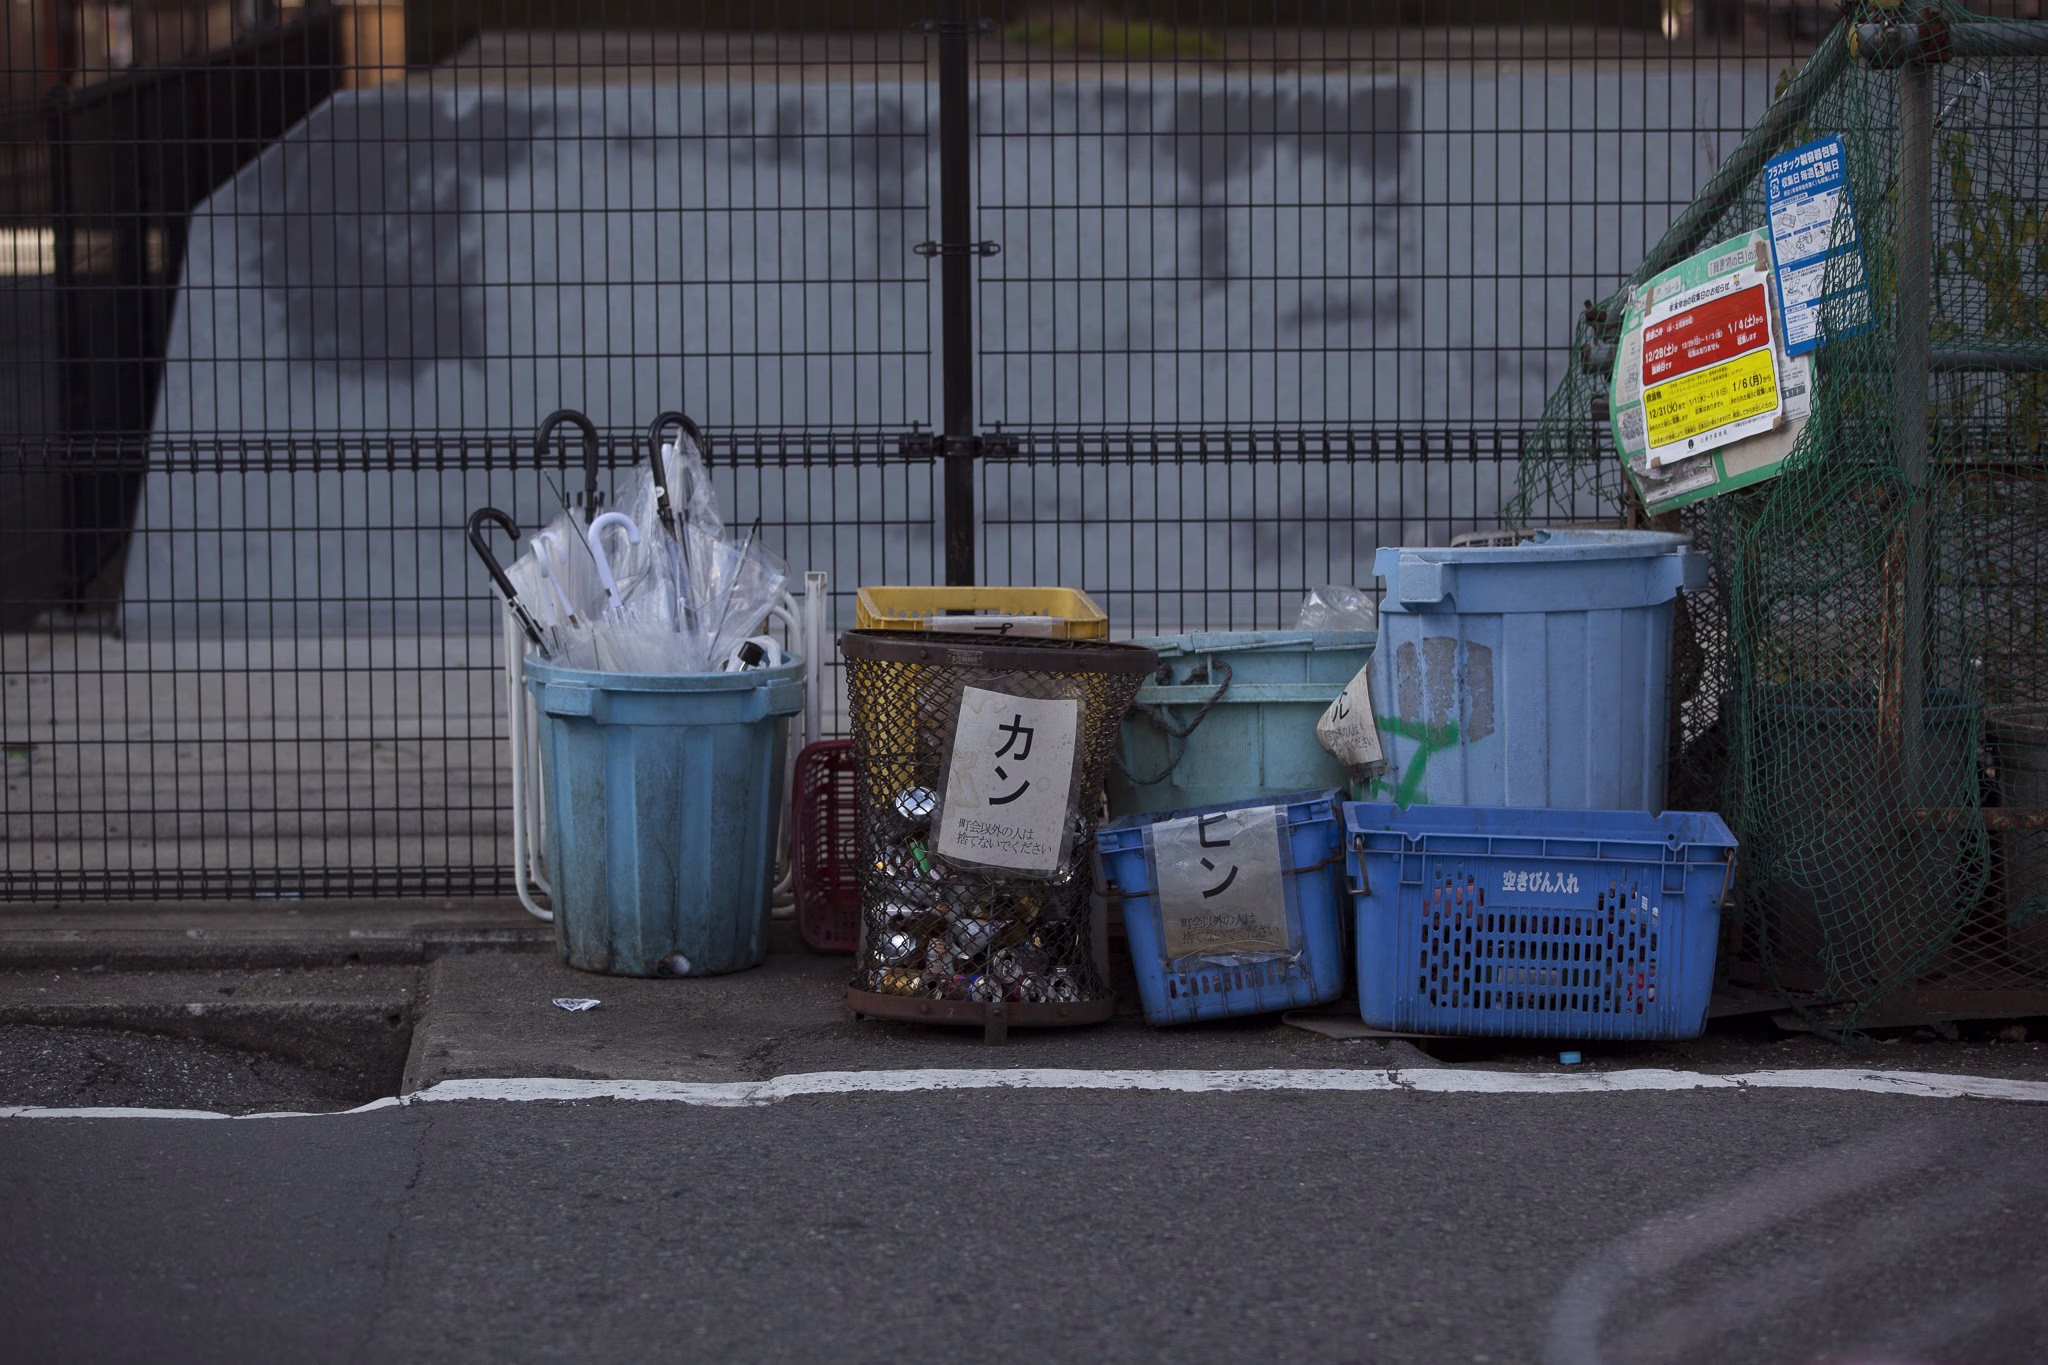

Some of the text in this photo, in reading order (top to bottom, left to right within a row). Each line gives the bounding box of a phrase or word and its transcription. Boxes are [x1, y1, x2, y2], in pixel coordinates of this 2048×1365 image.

[989, 714, 1035, 806] カン
[958, 818, 1034, 841] 町会以外の人は
[956, 831, 1052, 855] 捨てないでください
[1502, 870, 1580, 894] 空きびん入れ
[1180, 912, 1257, 930] 町会以外の人は
[1182, 925, 1280, 945] 捨てないでください
